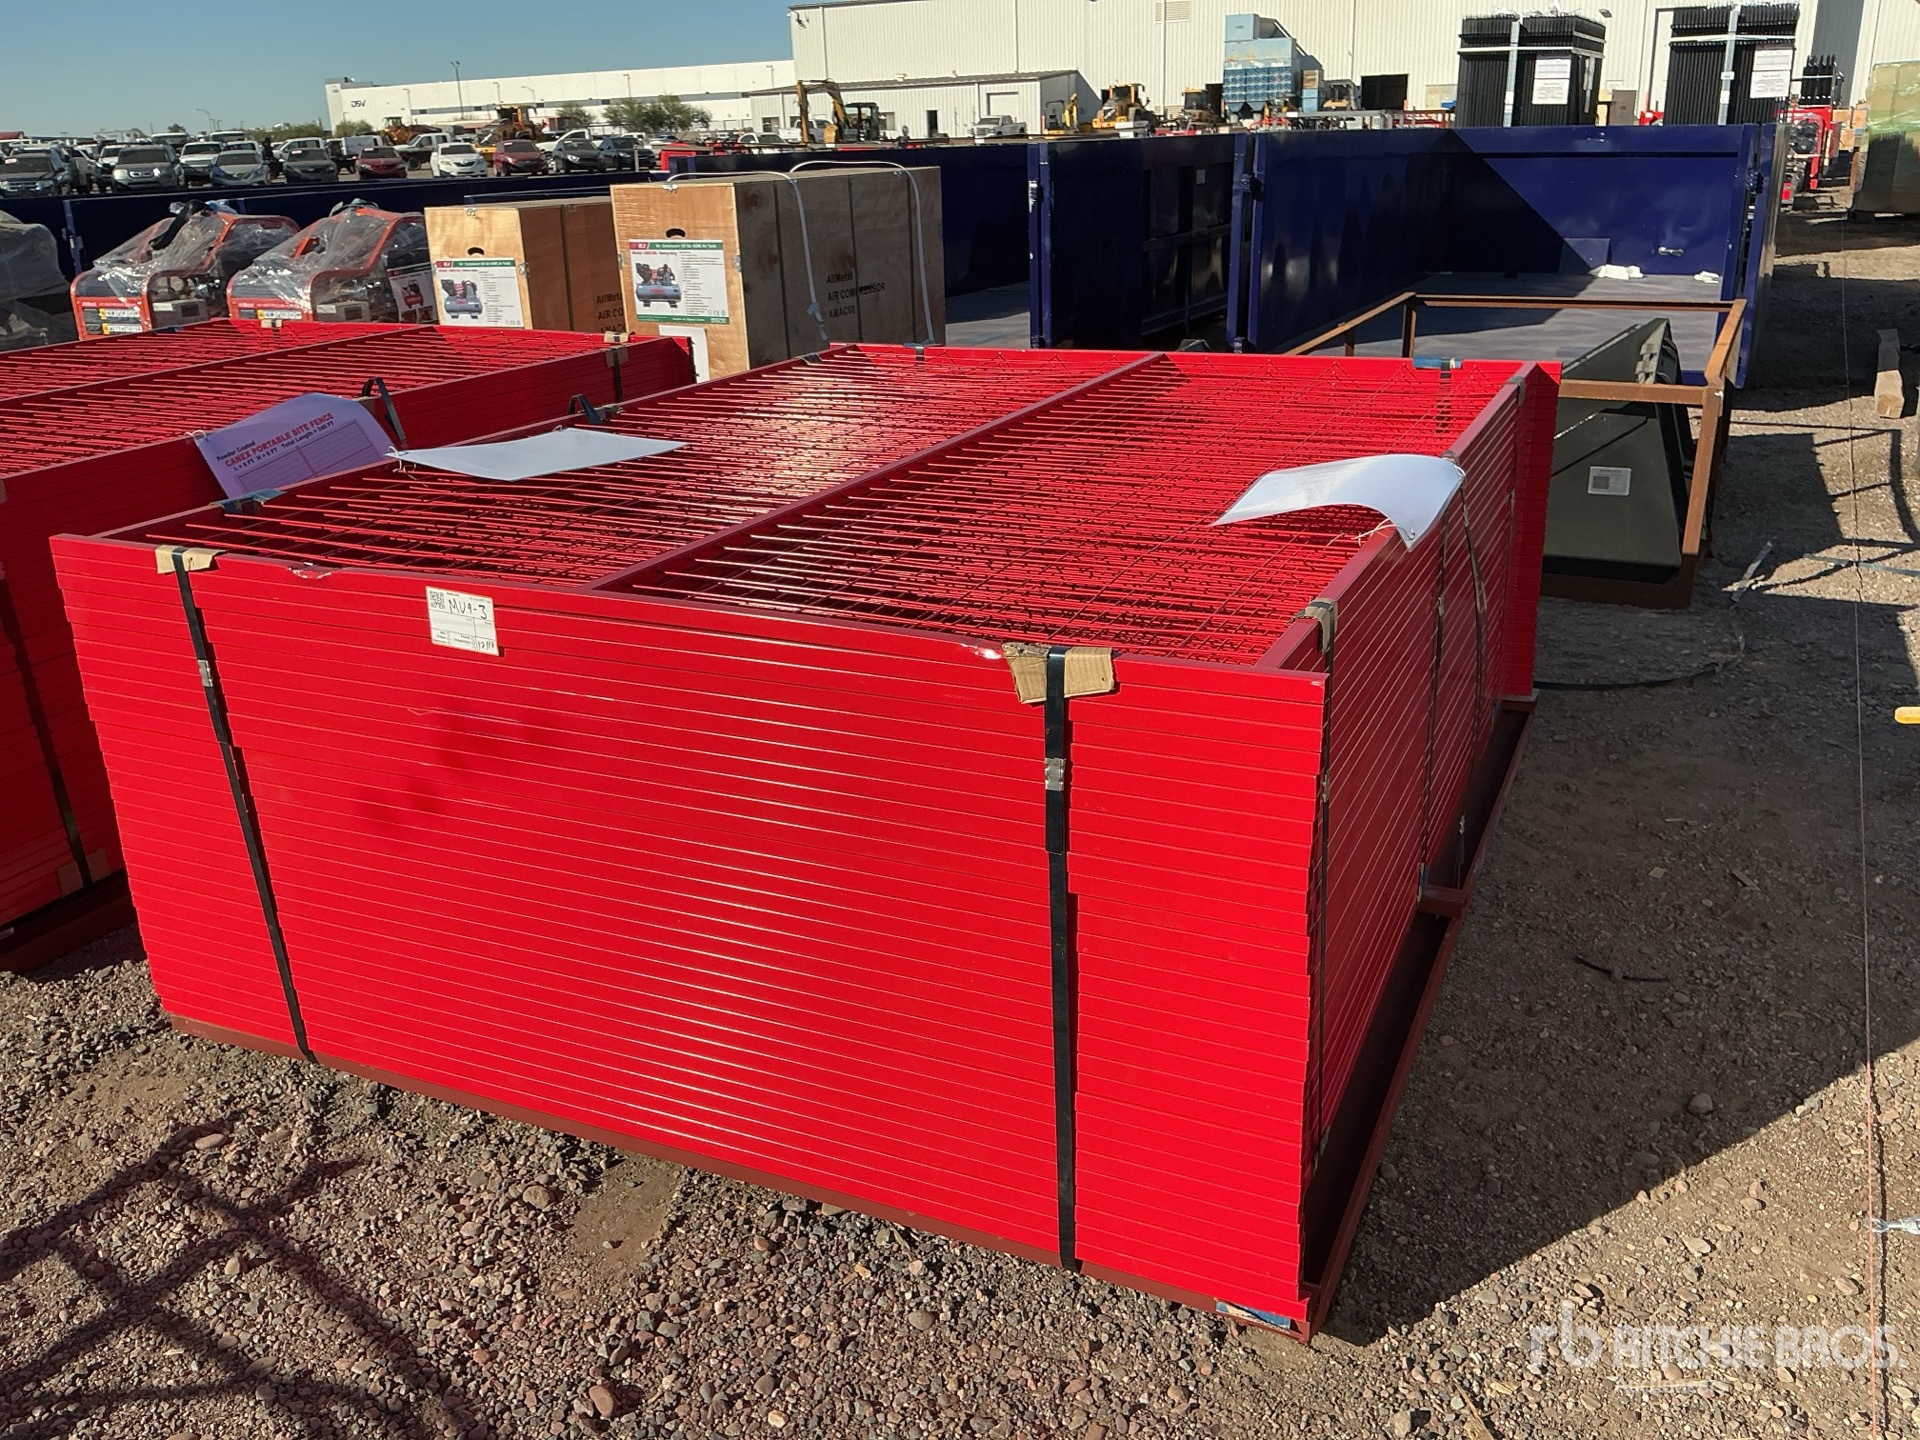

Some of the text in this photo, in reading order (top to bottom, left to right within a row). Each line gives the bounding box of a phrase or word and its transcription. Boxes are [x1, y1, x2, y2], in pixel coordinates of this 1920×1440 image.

[827, 290, 840, 302] AIR
[598, 309, 612, 321] AIR
[216, 440, 256, 462] Powder Coated
[225, 412, 335, 468] CANEX PORTABLE SITE FENCE
[247, 458, 255, 466] FT
[280, 440, 295, 450] Total
[295, 430, 314, 443] Length
[326, 420, 335, 428] FT
